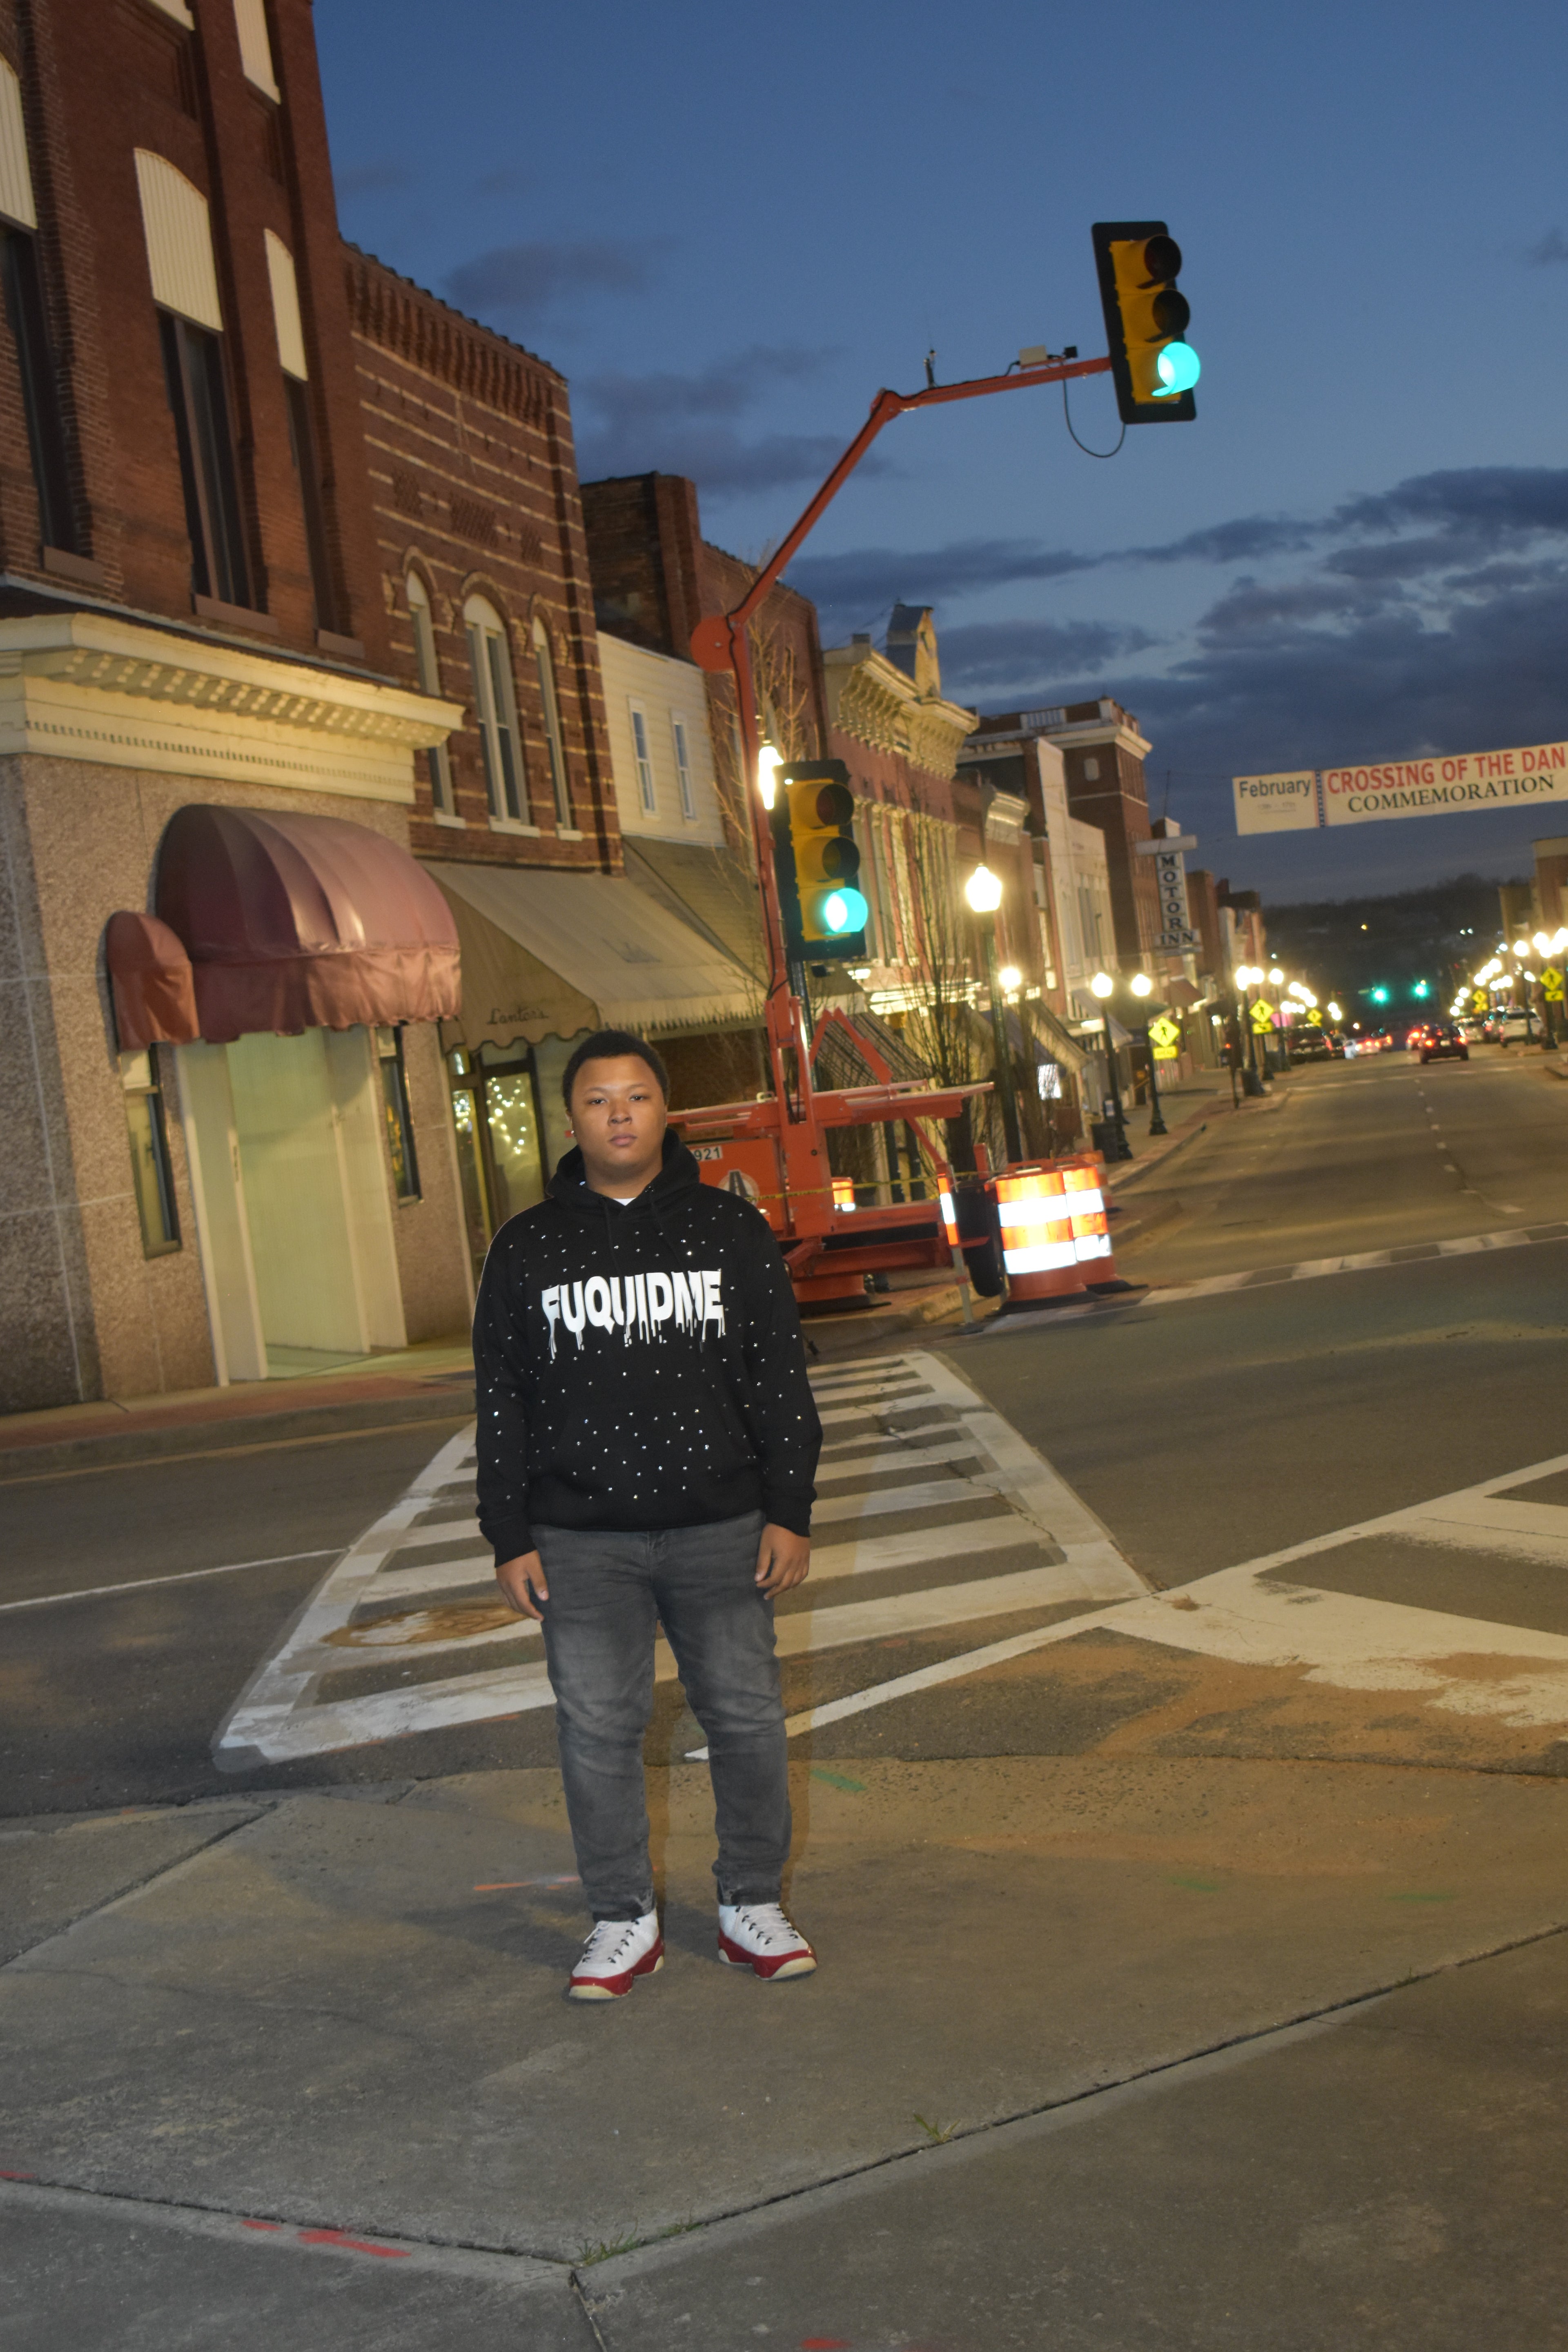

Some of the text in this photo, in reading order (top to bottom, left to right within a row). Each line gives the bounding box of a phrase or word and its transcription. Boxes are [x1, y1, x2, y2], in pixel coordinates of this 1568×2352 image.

[1239, 779, 1311, 798] February
[1327, 746, 1566, 794] CROSSING OF THE DAN
[1348, 774, 1554, 813] COMMEMORATION
[1161, 855, 1182, 929] MOTOR
[1160, 931, 1193, 945] INN
